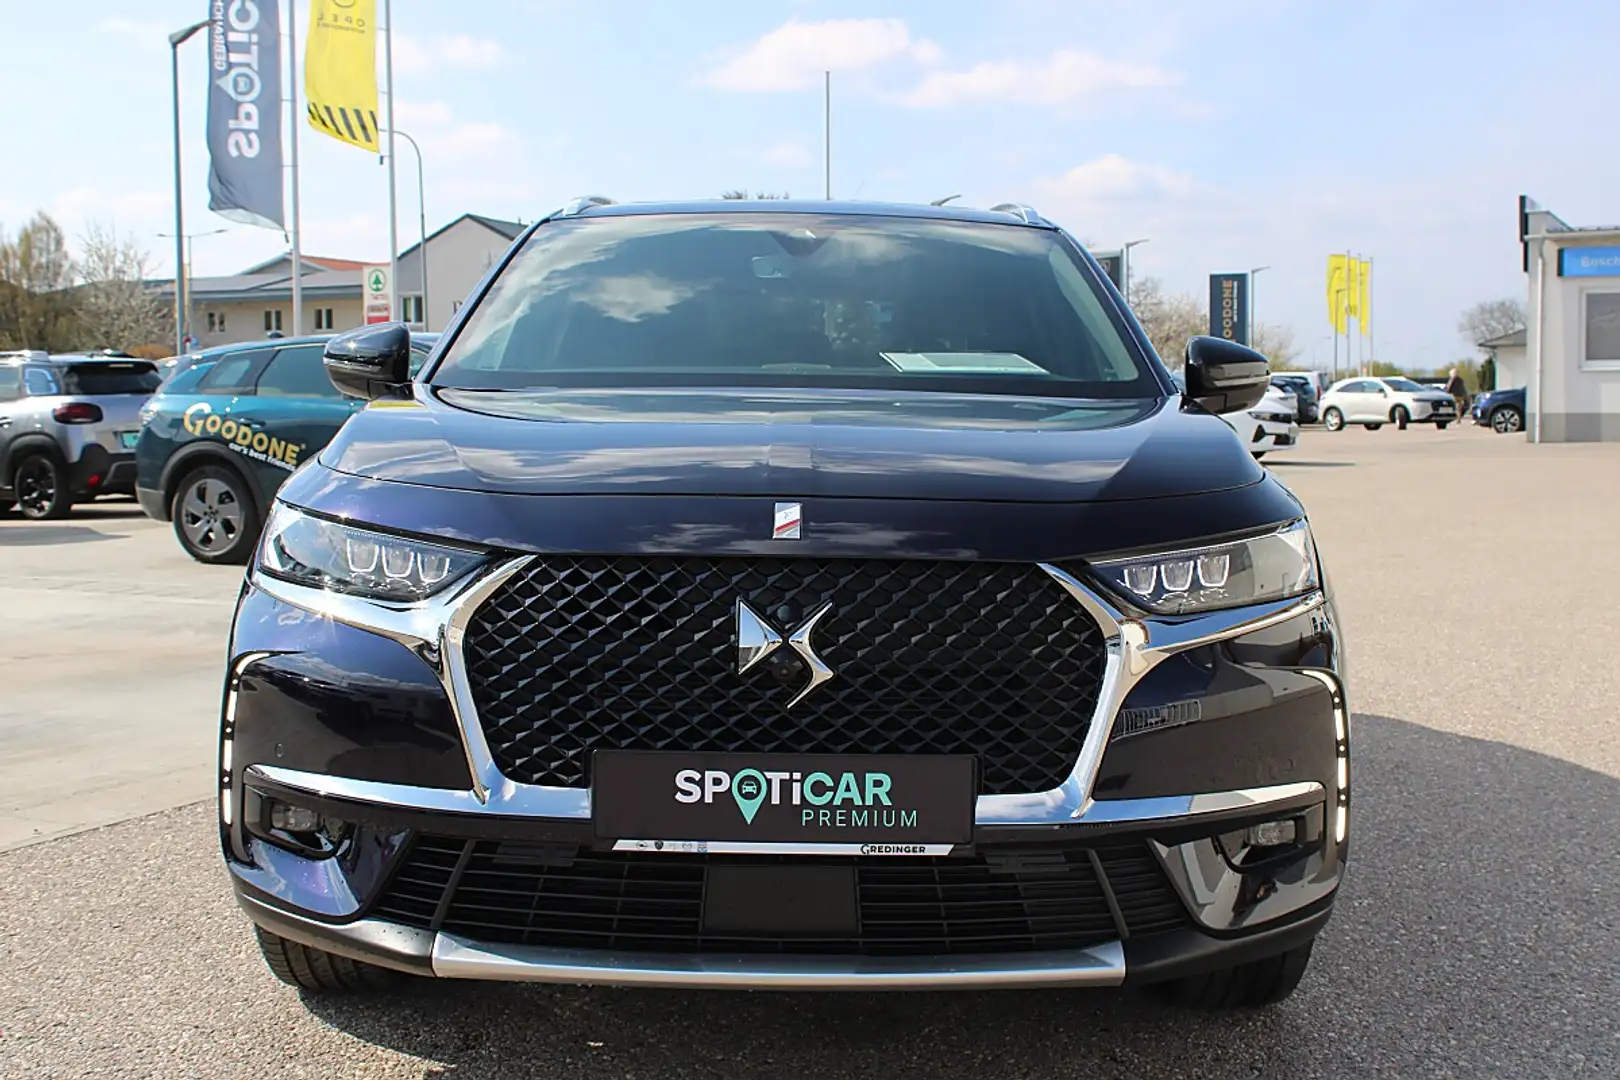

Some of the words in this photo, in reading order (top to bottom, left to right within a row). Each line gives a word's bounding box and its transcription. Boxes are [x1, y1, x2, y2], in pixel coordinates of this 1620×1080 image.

[1222, 279, 1234, 340] OODONE
[801, 810, 918, 828] PREMIUM
[860, 844, 926, 855] GREDINGER
